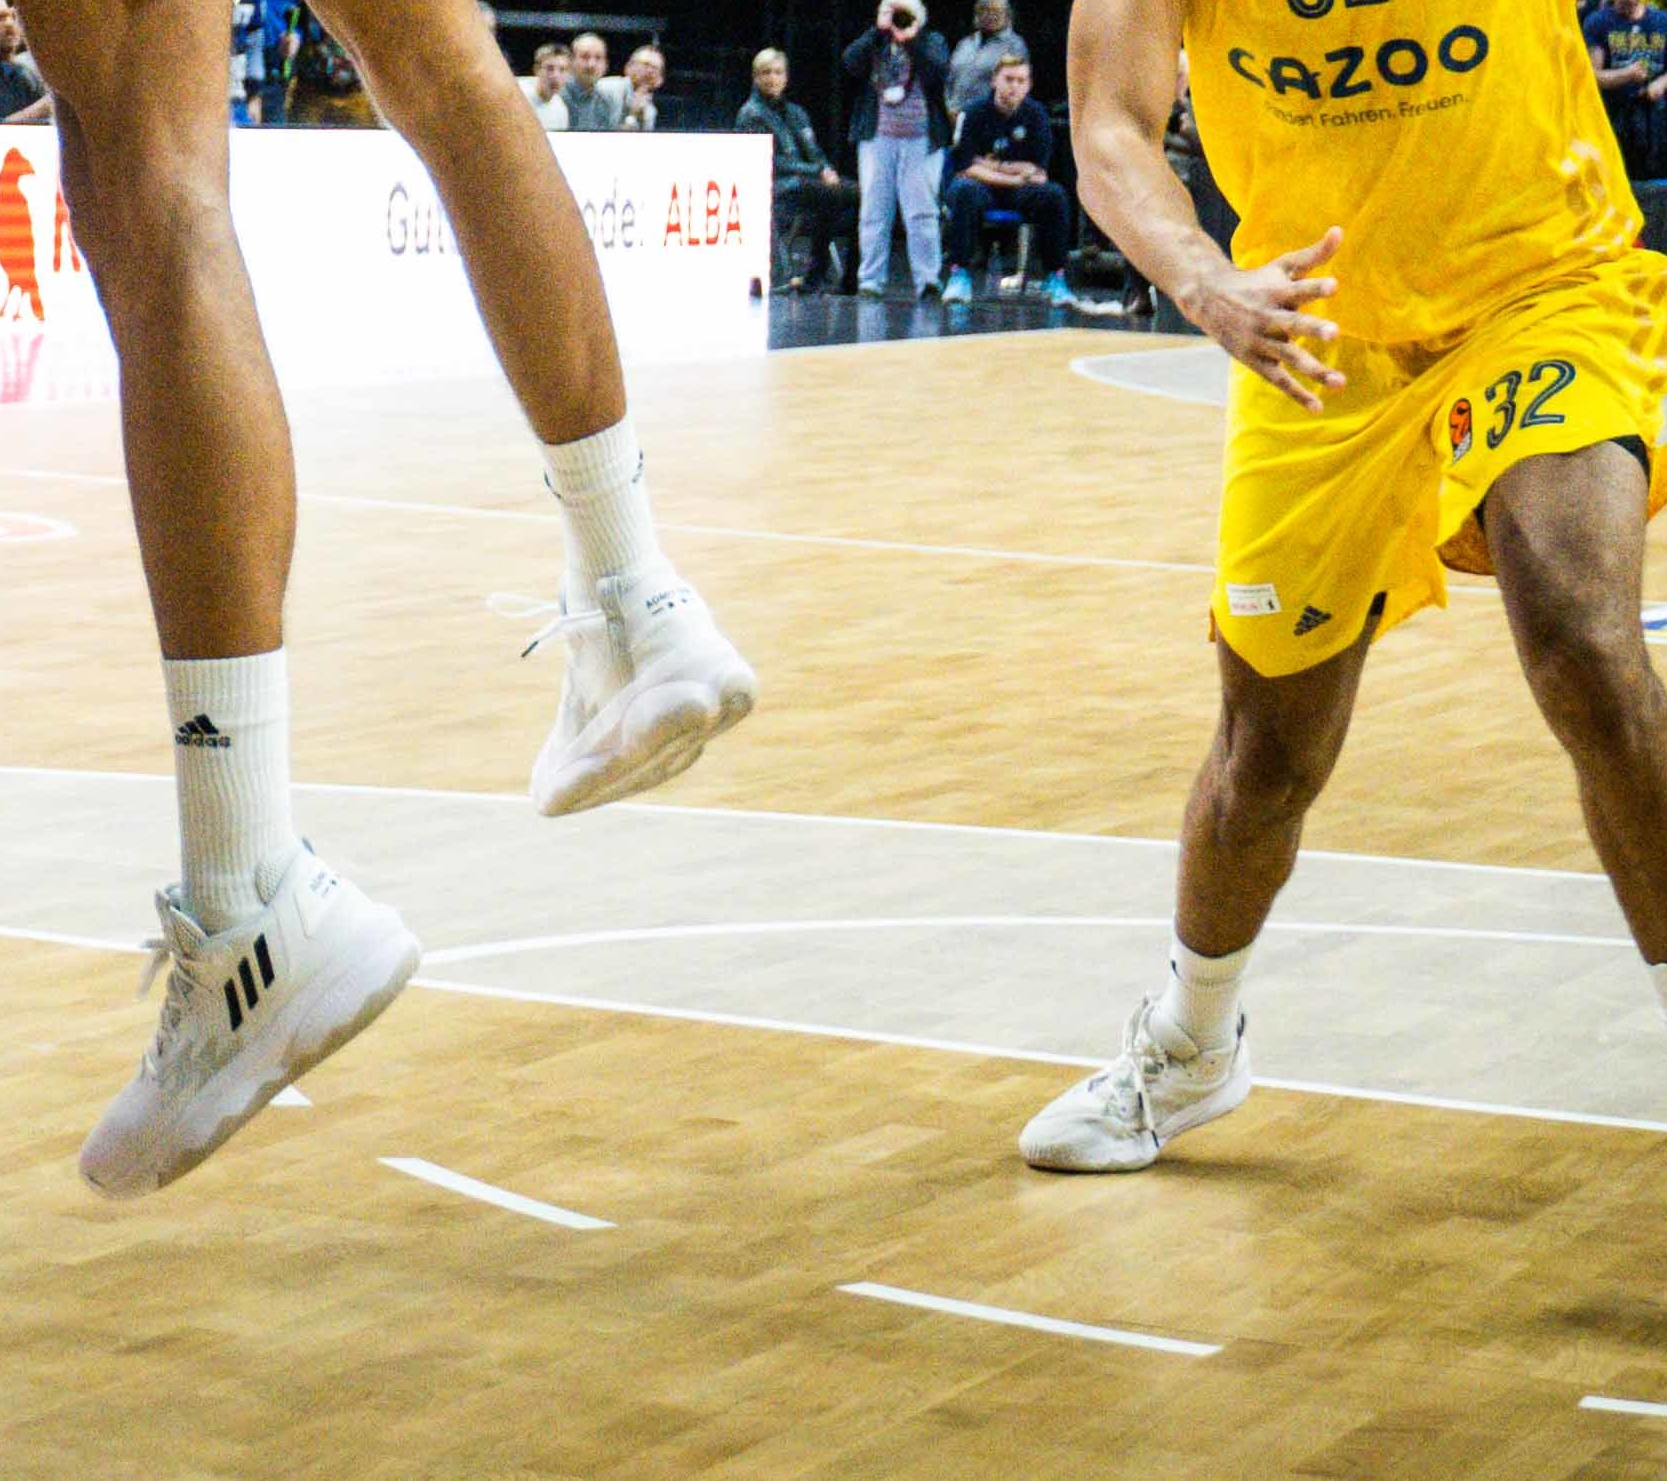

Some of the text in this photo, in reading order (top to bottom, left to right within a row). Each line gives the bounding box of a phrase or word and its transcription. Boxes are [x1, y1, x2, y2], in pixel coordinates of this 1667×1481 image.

[1228, 25, 1489, 100] CAZOO
[663, 180, 743, 248] ALBA
[1484, 359, 1577, 450] 32
